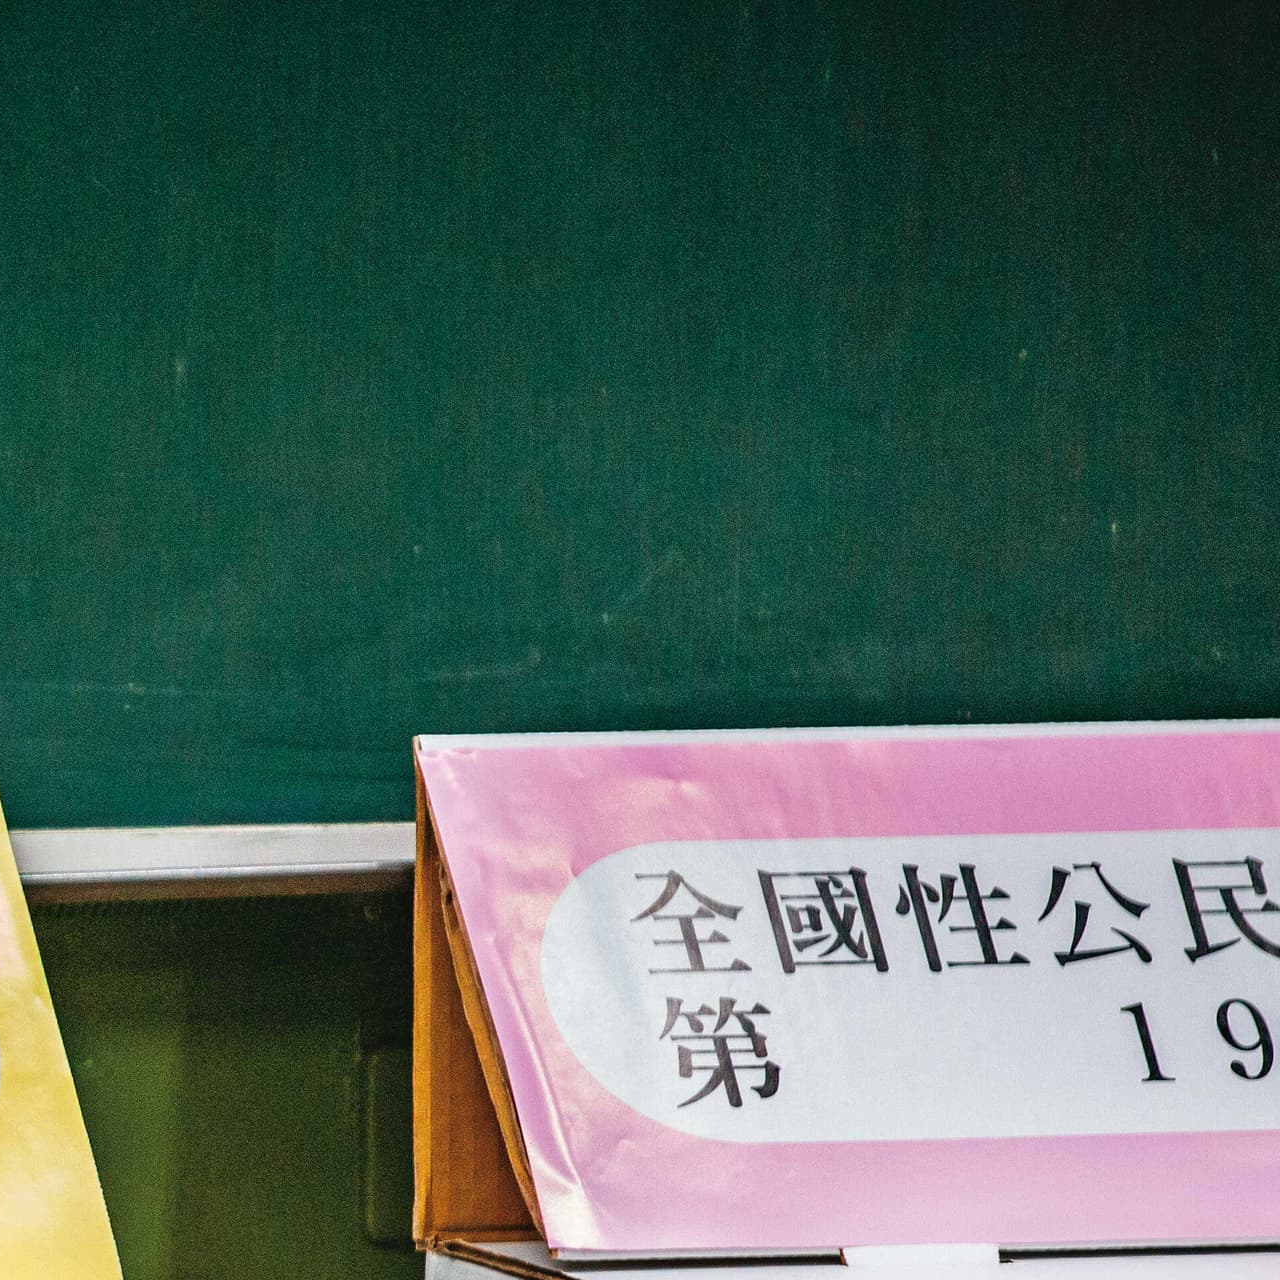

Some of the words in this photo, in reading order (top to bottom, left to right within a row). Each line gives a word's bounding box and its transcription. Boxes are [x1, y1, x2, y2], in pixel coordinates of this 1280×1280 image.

[633, 856, 1280, 976] 全國性公民
[659, 996, 782, 1109] 第
[1119, 997, 1276, 1083] 19
